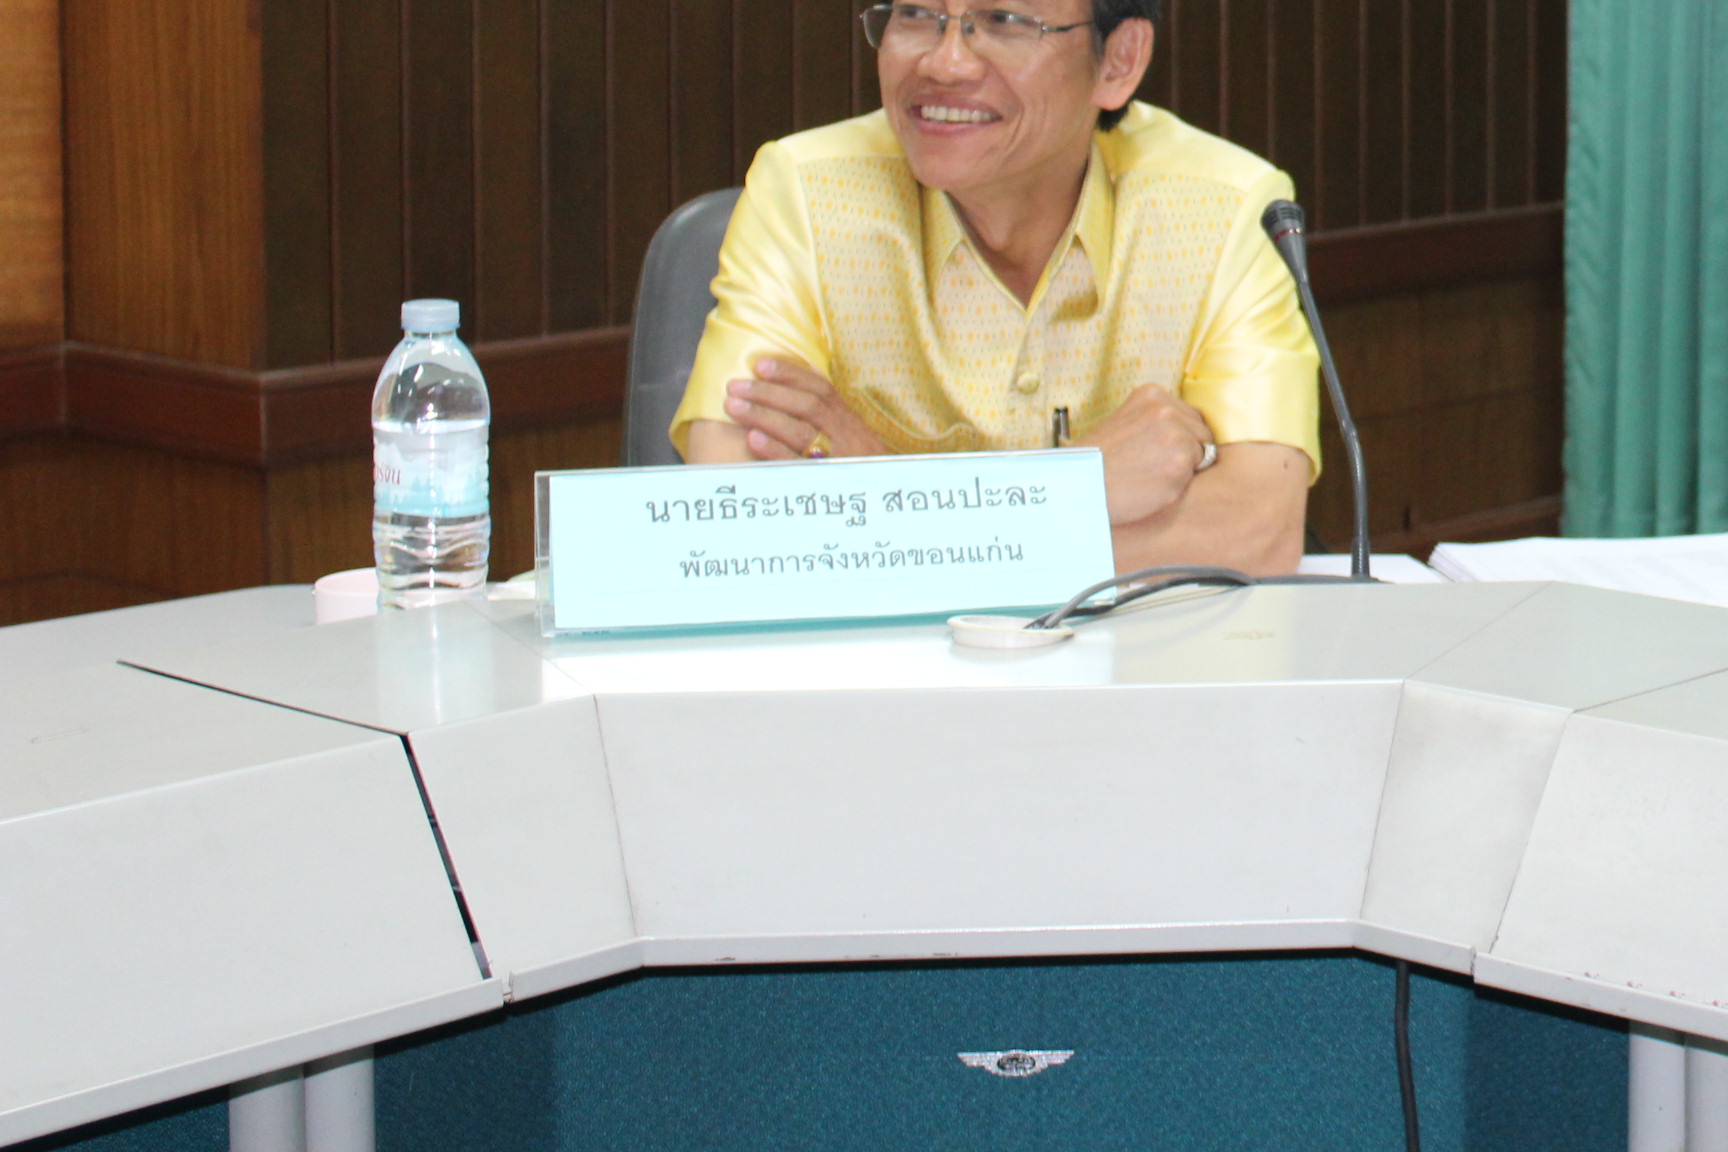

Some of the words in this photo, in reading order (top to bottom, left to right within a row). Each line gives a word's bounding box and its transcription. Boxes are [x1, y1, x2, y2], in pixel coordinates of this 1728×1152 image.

[645, 484, 867, 528] นายธีระเชษฐ
[881, 475, 1048, 513] สอนปะละ
[679, 535, 1025, 579] พัฒนาการจังหวัดขอนแก่น
